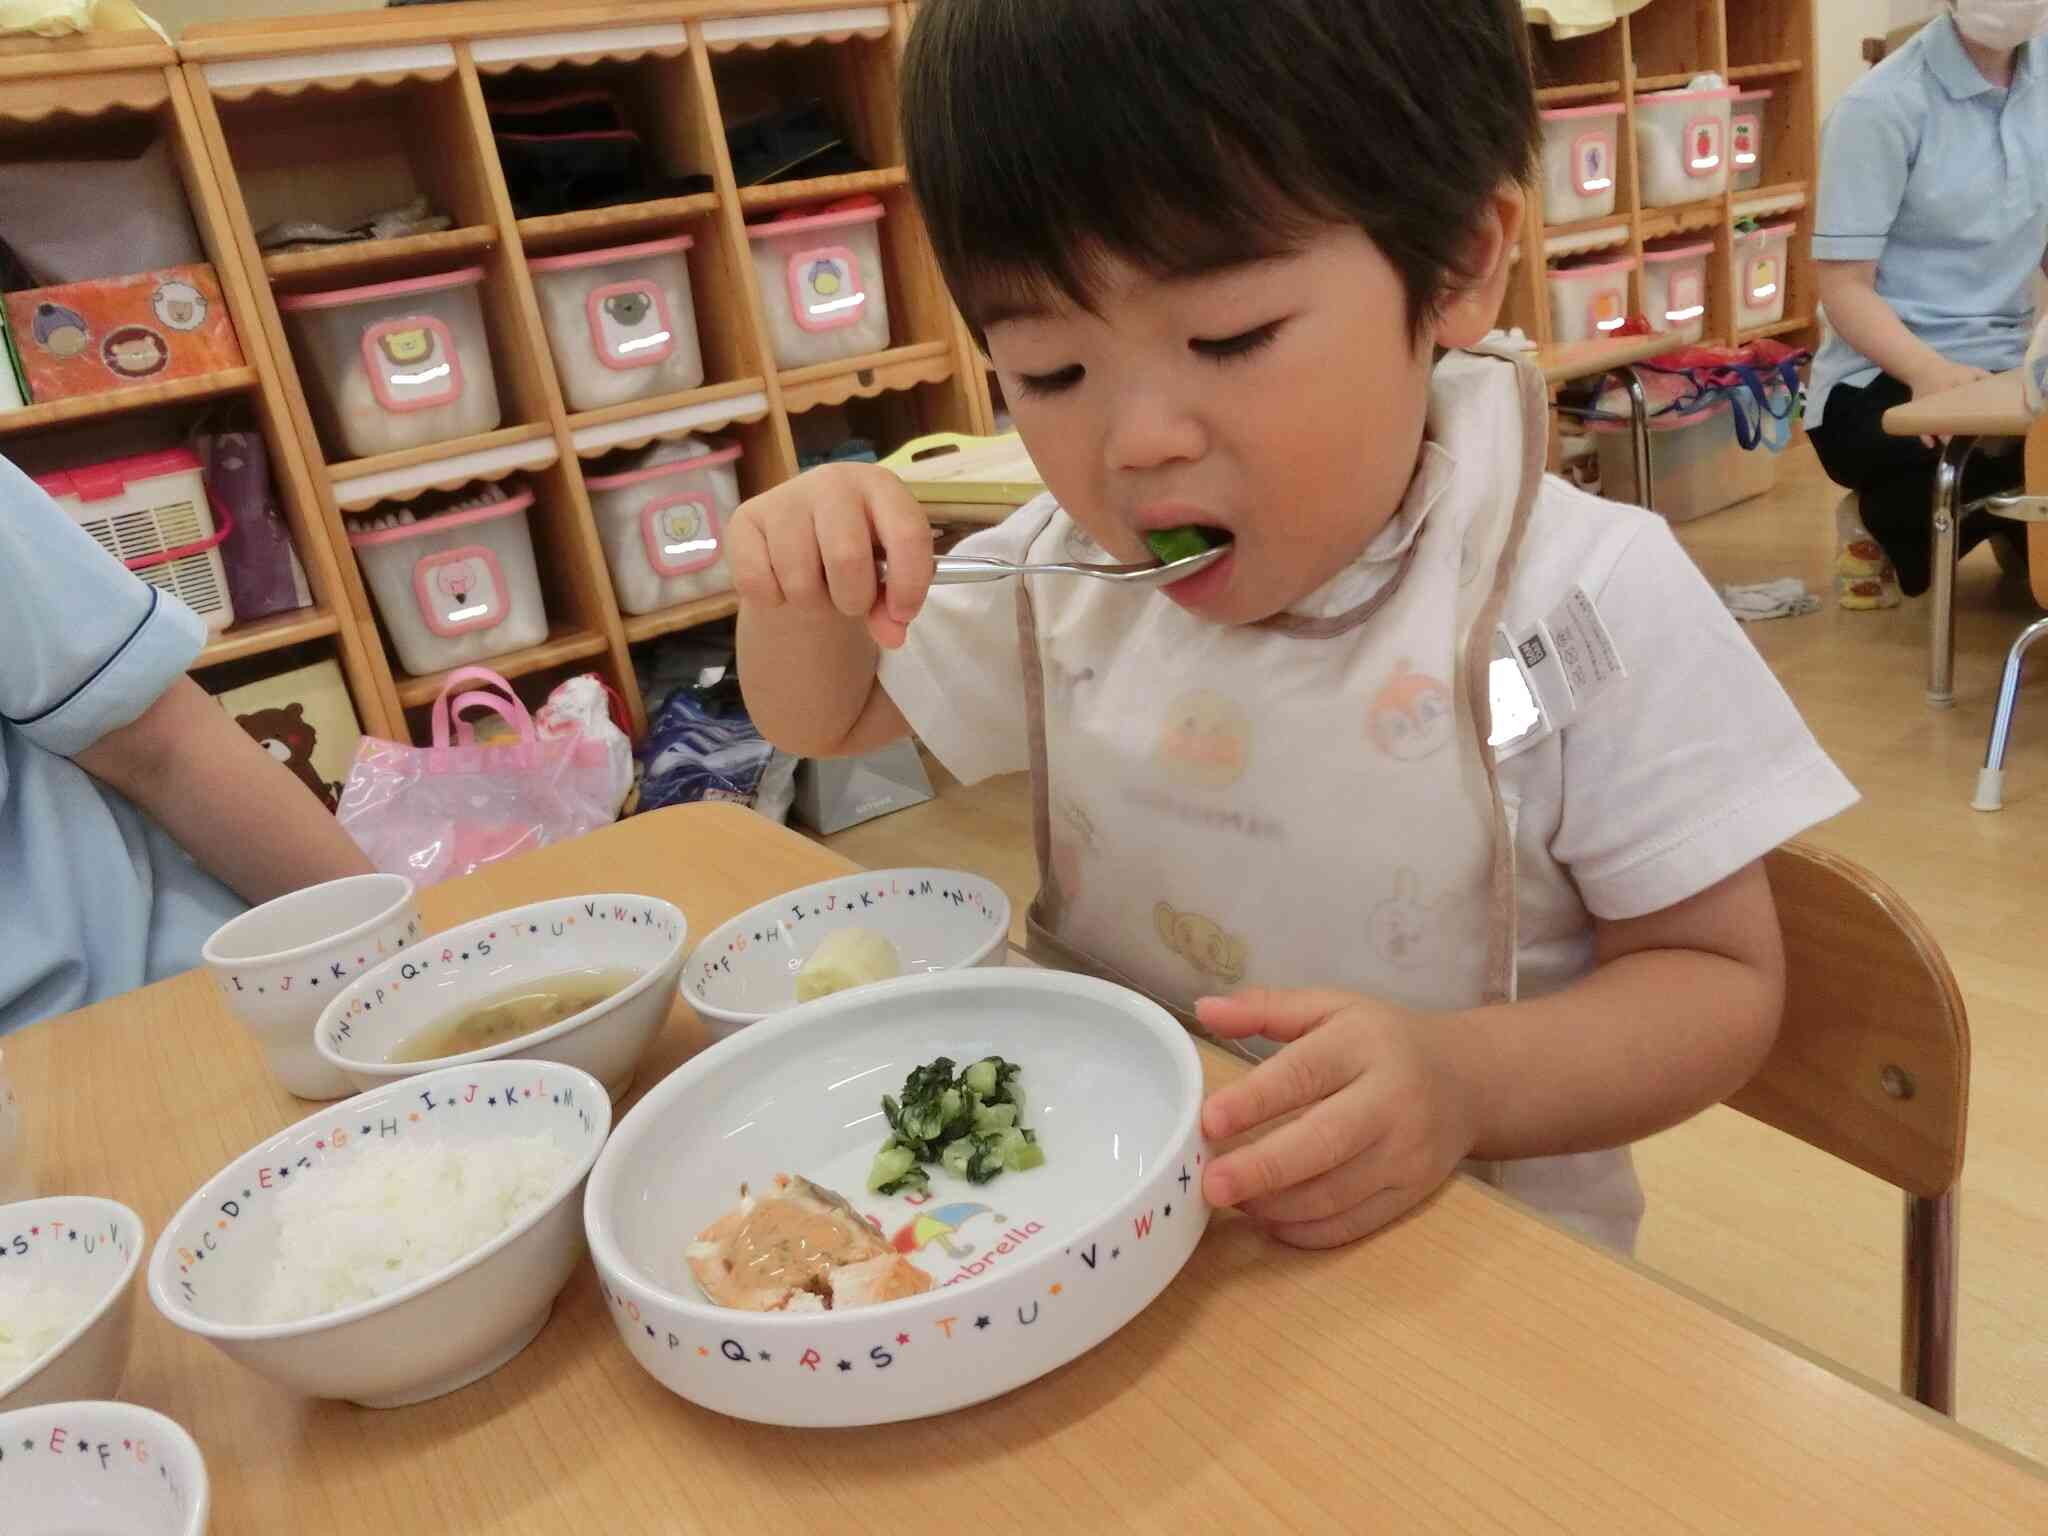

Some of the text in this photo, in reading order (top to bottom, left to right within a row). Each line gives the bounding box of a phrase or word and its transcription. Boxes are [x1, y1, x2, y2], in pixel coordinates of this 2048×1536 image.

[766, 928, 778, 942] H
[792, 904, 806, 920] I
[826, 896, 837, 911] J
[860, 892, 874, 906] K
[920, 880, 934, 895] M
[951, 889, 965, 907] N
[232, 976, 243, 991] I
[281, 976, 293, 991] J
[331, 963, 346, 979] K
[376, 989, 385, 1004] P
[401, 963, 420, 980] Q
[441, 949, 453, 963] R
[477, 940, 491, 955] S
[511, 923, 524, 936] T
[551, 922, 564, 937] U
[585, 902, 596, 917] V
[614, 906, 627, 921] W
[643, 908, 654, 926] X
[203, 1231, 217, 1250] C
[220, 1201, 240, 1217] D
[259, 1168, 273, 1189] E
[332, 1127, 348, 1148] G
[381, 1117, 397, 1138] H
[420, 1091, 436, 1110] I
[464, 1084, 479, 1104] J
[505, 1086, 518, 1107] K
[537, 1080, 547, 1097] L
[563, 1087, 575, 1108] M
[12, 1220, 118, 1255] S T U V
[943, 1220, 1046, 1287] mbrella
[721, 1339, 751, 1363] Q
[800, 1348, 821, 1372] R
[870, 1345, 893, 1368] S
[935, 1316, 958, 1338] T
[1018, 1300, 1039, 1325] U
[1080, 1243, 1097, 1270] V
[1133, 1208, 1154, 1240] W
[50, 1426, 67, 1455] E
[96, 1443, 111, 1471] F
